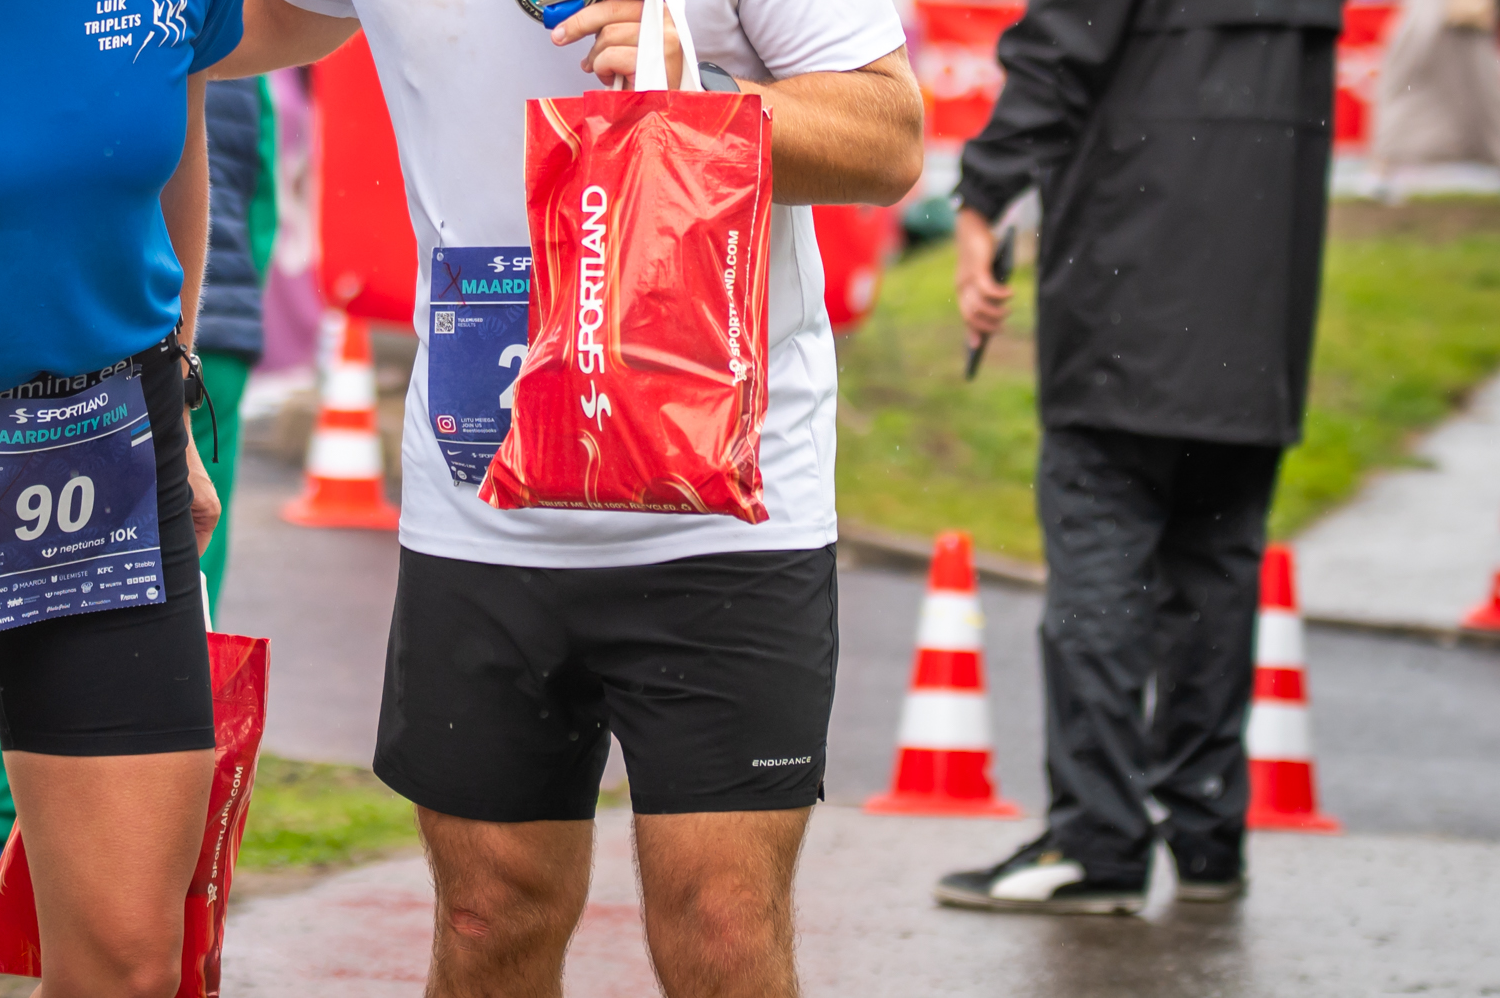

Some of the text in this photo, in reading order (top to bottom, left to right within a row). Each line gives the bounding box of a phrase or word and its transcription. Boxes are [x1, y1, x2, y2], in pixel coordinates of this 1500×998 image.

[84, 13, 142, 36] TRIPLETS
[97, 32, 133, 51] TEAM
[577, 184, 608, 375] SPORTLAND
[36, 392, 109, 423] SPORTLAND
[64, 416, 101, 438] CITY
[102, 403, 128, 426] RUN
[14, 475, 95, 541] 90
[538, 500, 569, 508] TRUST
[109, 526, 138, 544] 10K
[19, 578, 47, 589] MAARDU
[58, 570, 89, 581] ÜLEMISTE
[97, 566, 113, 575] KFC
[134, 561, 156, 569] Stebby
[752, 756, 812, 767] ENDURANCE
[212, 766, 243, 878] SPORTLAND.COM
